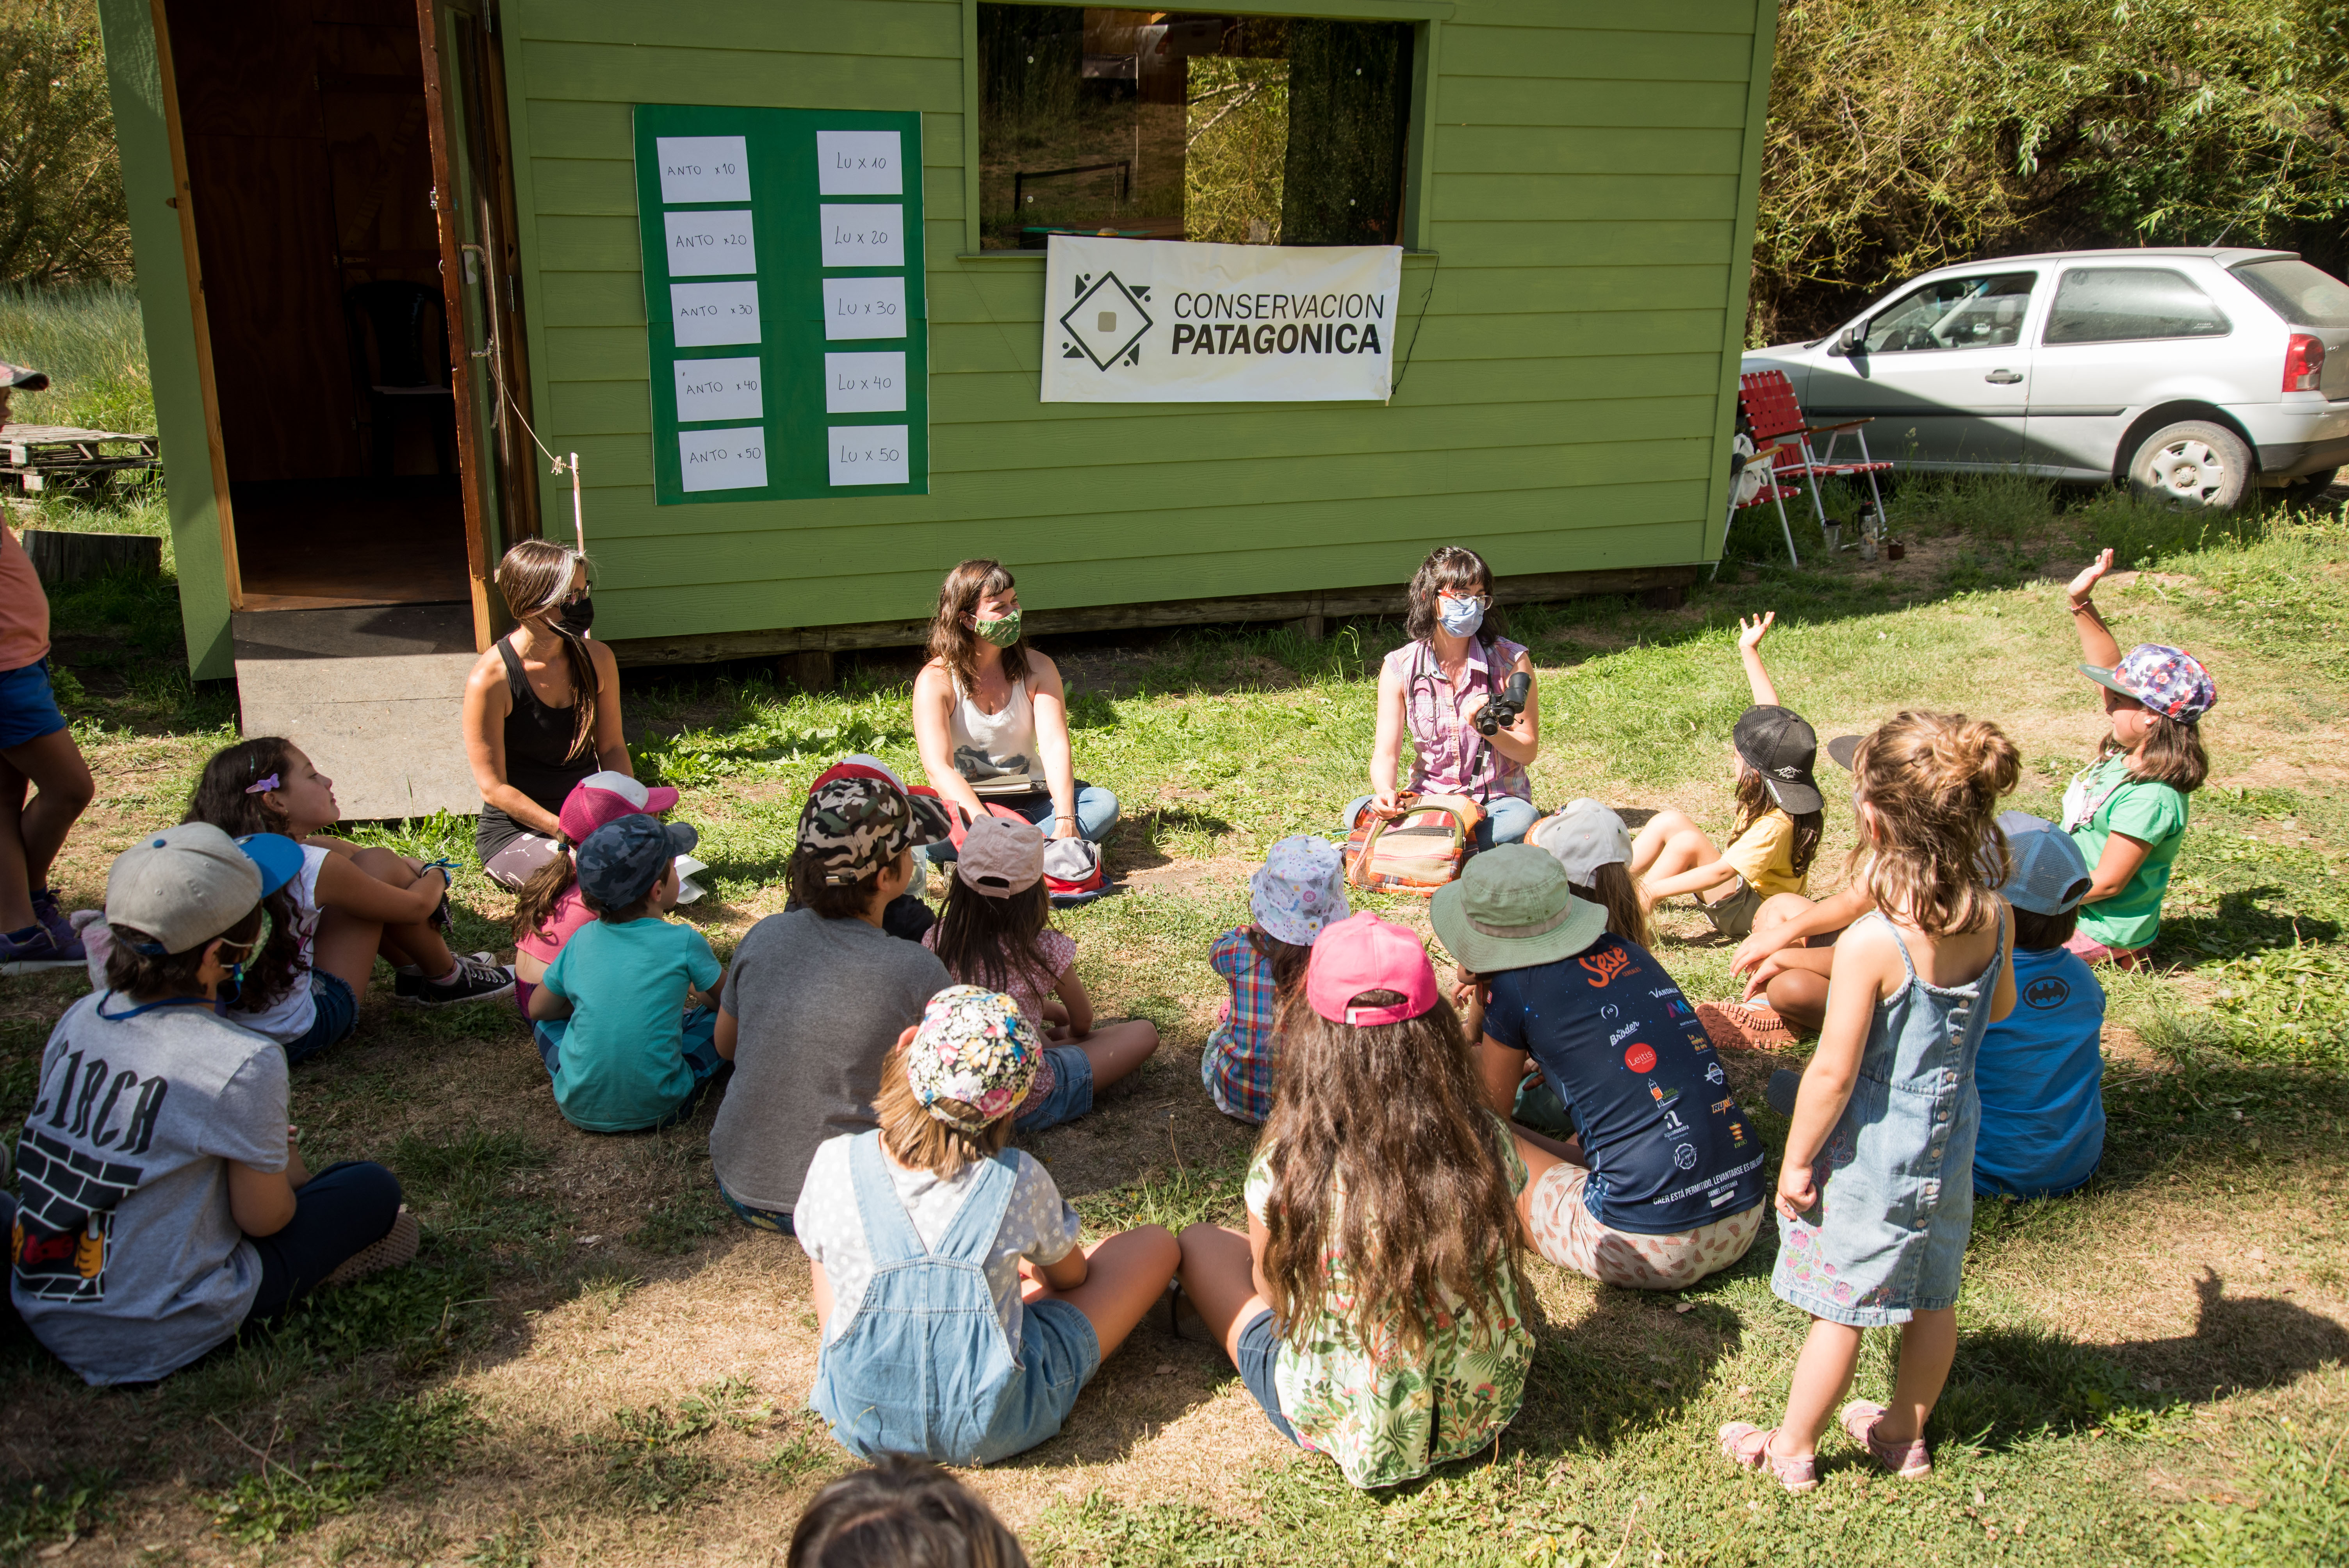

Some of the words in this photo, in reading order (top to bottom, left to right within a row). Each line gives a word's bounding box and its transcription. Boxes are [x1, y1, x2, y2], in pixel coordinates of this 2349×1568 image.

[668, 165, 701, 176] ANTO
[676, 234, 714, 248] ANTO
[681, 305, 717, 317] ANTO
[1174, 293, 1384, 319] CONSERVACION
[1172, 323, 1382, 355] PATAGONICA
[687, 381, 723, 395] ANTO
[690, 449, 727, 464] ANTO
[1622, 966, 1642, 977] CEREALES
[1649, 987, 1679, 998] VANDALIA
[1628, 1051, 1653, 1066] Leitis
[1664, 1125, 1690, 1138] aguanuestra
[1653, 1195, 1670, 1205] CAER
[1670, 1188, 1685, 1202] ESTÁ
[1685, 1178, 1714, 1197] PERMITIDO,
[1713, 1165, 1744, 1185] LEVANTARSE
[1743, 1163, 1750, 1172] ES
[1708, 1189, 1721, 1198] DANIEL
[1721, 1180, 1738, 1192] ESTEFANÍA
